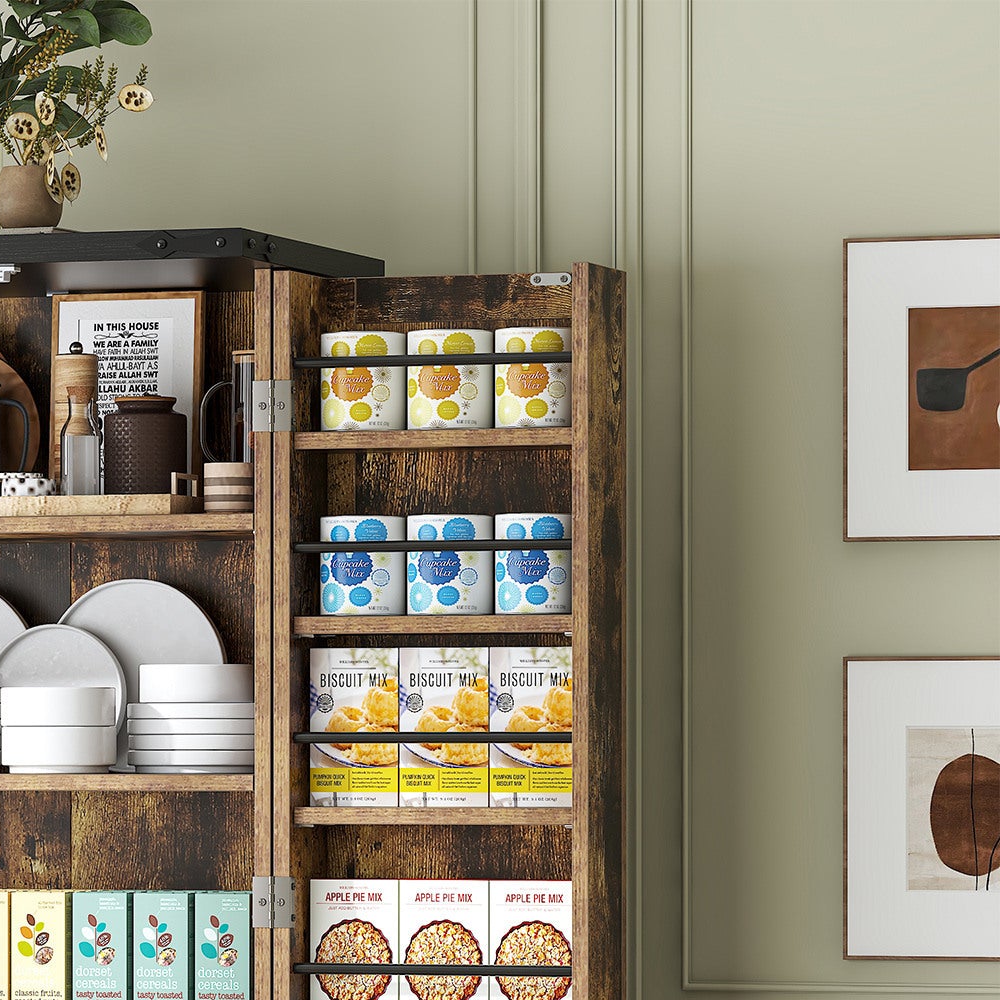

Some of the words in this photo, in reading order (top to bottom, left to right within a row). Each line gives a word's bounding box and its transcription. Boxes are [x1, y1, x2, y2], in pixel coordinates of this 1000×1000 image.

[107, 323, 126, 331] THIS
[129, 322, 159, 330] HOUSE
[332, 375, 370, 386] Cupcake
[421, 374, 457, 384] Cupcake
[508, 372, 546, 382] Cupcake
[129, 384, 157, 392] AKBAR
[346, 384, 365, 393] Mix
[433, 382, 452, 391] Mix
[521, 381, 541, 390] Mix
[333, 559, 369, 570] Cupcake
[420, 558, 458, 569] Cupcake
[508, 558, 546, 568] Cupcake
[345, 568, 365, 577] Mix
[433, 567, 452, 577] Mix
[521, 566, 541, 576] Mix
[320, 673, 363, 687] BISCUIT
[369, 673, 387, 686] MIX
[410, 673, 452, 687] BISCUIT
[459, 673, 478, 686] MIX
[500, 673, 544, 686] BISCUIT
[550, 672, 569, 686] MIX
[325, 893, 350, 901] APPLE
[353, 893, 366, 901] PIE
[368, 893, 382, 901] MIX
[415, 893, 440, 902] APPLE
[442, 894, 455, 902] PIE
[458, 894, 472, 902] MIX
[505, 894, 530, 903] APPLE
[533, 894, 546, 903] PIE
[549, 894, 563, 903] MIX
[76, 966, 112, 976] dorset
[137, 967, 173, 977] dorset
[198, 967, 235, 978] dorset
[76, 978, 116, 988] cereals
[137, 979, 177, 989] cereals
[198, 980, 239, 990] cereals
[76, 991, 94, 999] tasty
[198, 992, 217, 1000] tasty
